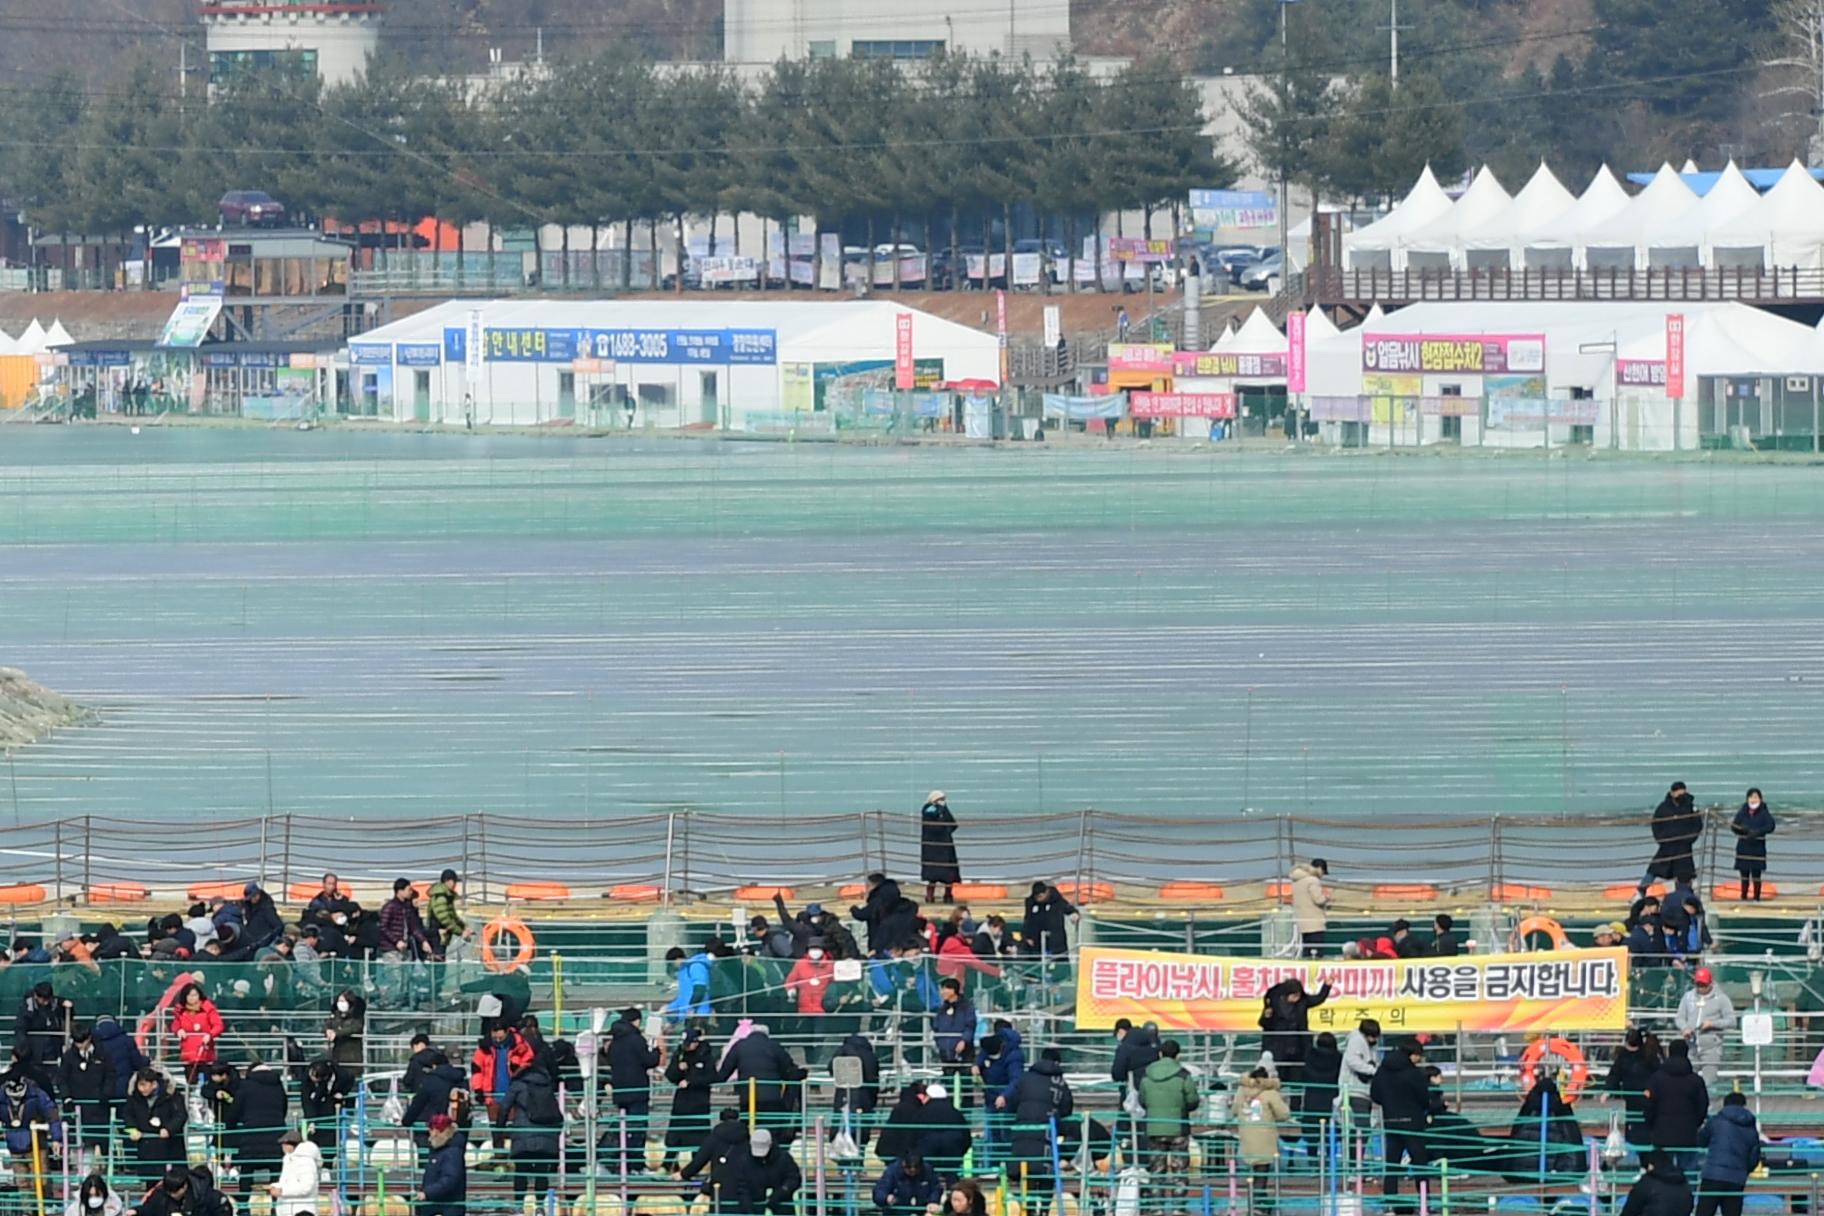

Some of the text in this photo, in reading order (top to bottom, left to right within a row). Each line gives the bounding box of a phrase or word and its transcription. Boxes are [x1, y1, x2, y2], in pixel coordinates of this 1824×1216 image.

[1094, 960, 1226, 999] 플라이낚시,
[1400, 965, 1478, 999] 사용을
[1485, 961, 1618, 998] 금지합니다.
